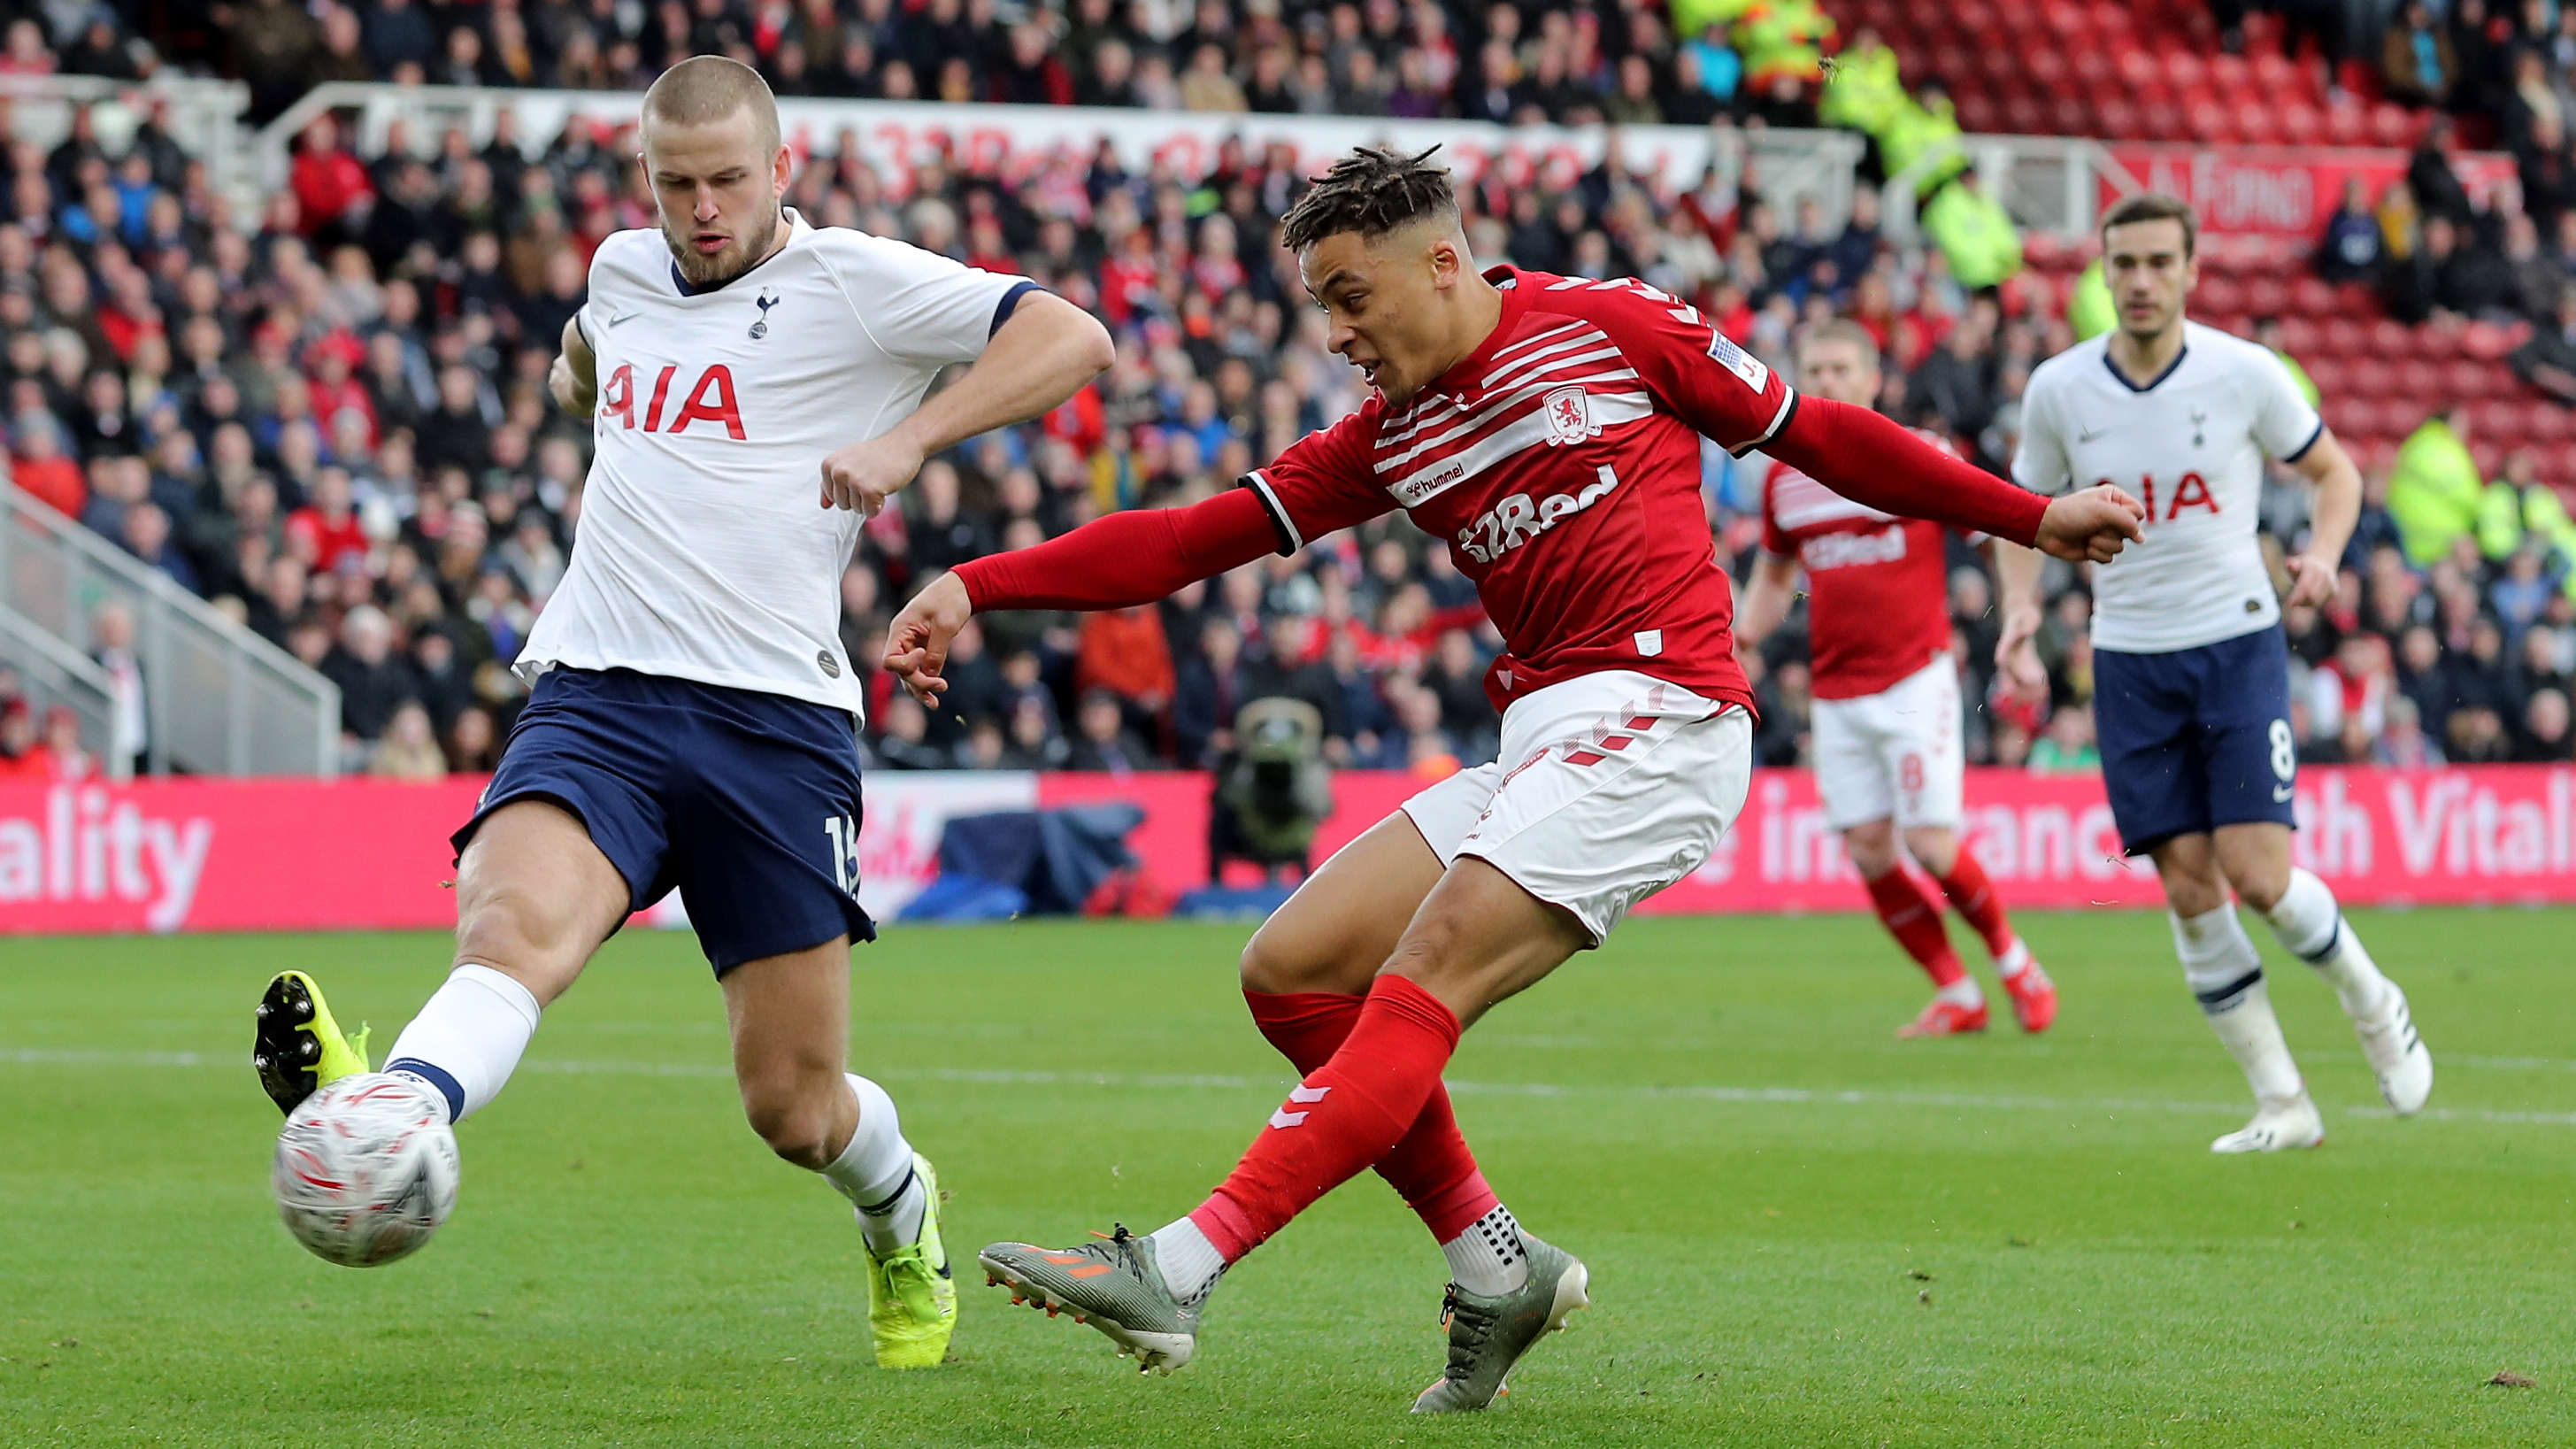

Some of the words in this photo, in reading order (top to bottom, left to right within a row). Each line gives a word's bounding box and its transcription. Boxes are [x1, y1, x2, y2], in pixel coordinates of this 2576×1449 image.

[601, 364, 747, 441] AIA
[1419, 461, 1465, 493] hummel
[2095, 471, 2219, 525] IA
[1902, 751, 1925, 792] 8
[2268, 718, 2296, 782] 8
[0, 782, 216, 934] ality
